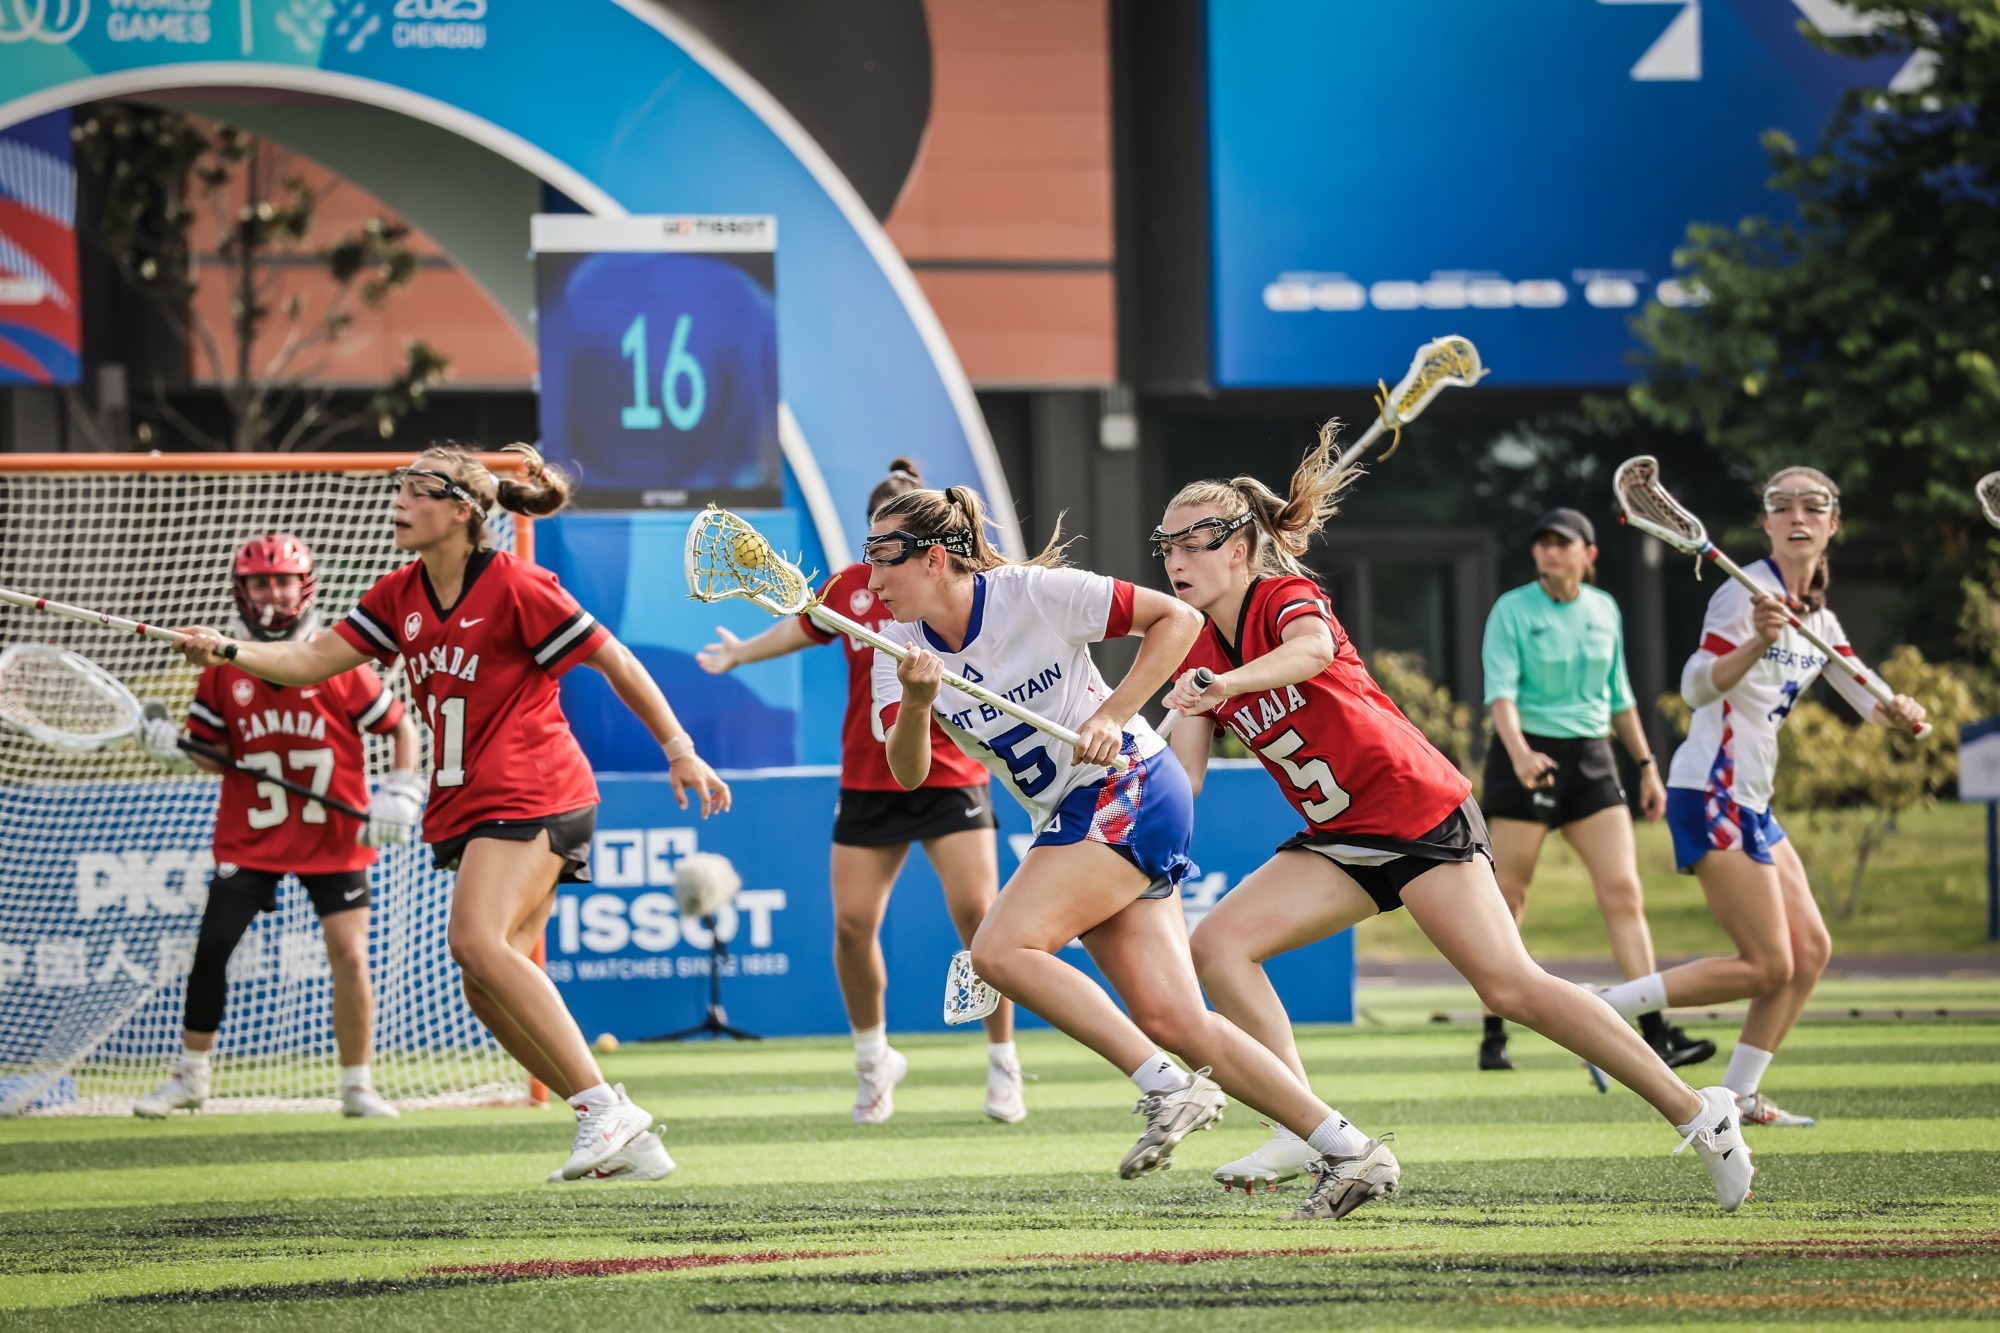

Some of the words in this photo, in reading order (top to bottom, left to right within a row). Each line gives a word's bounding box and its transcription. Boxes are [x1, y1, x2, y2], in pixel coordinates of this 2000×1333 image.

[107, 12, 211, 44] GAMES
[620, 313, 706, 432] 16
[917, 538, 942, 547] GAIT
[946, 533, 963, 544] GAI
[237, 709, 327, 742] CANADA
[1228, 684, 1307, 746] NADA
[236, 748, 335, 830] 37
[988, 722, 1057, 798] 5
[1258, 726, 1351, 825] 5
[549, 888, 787, 955] ISSOT
[576, 957, 674, 982] WATCHES
